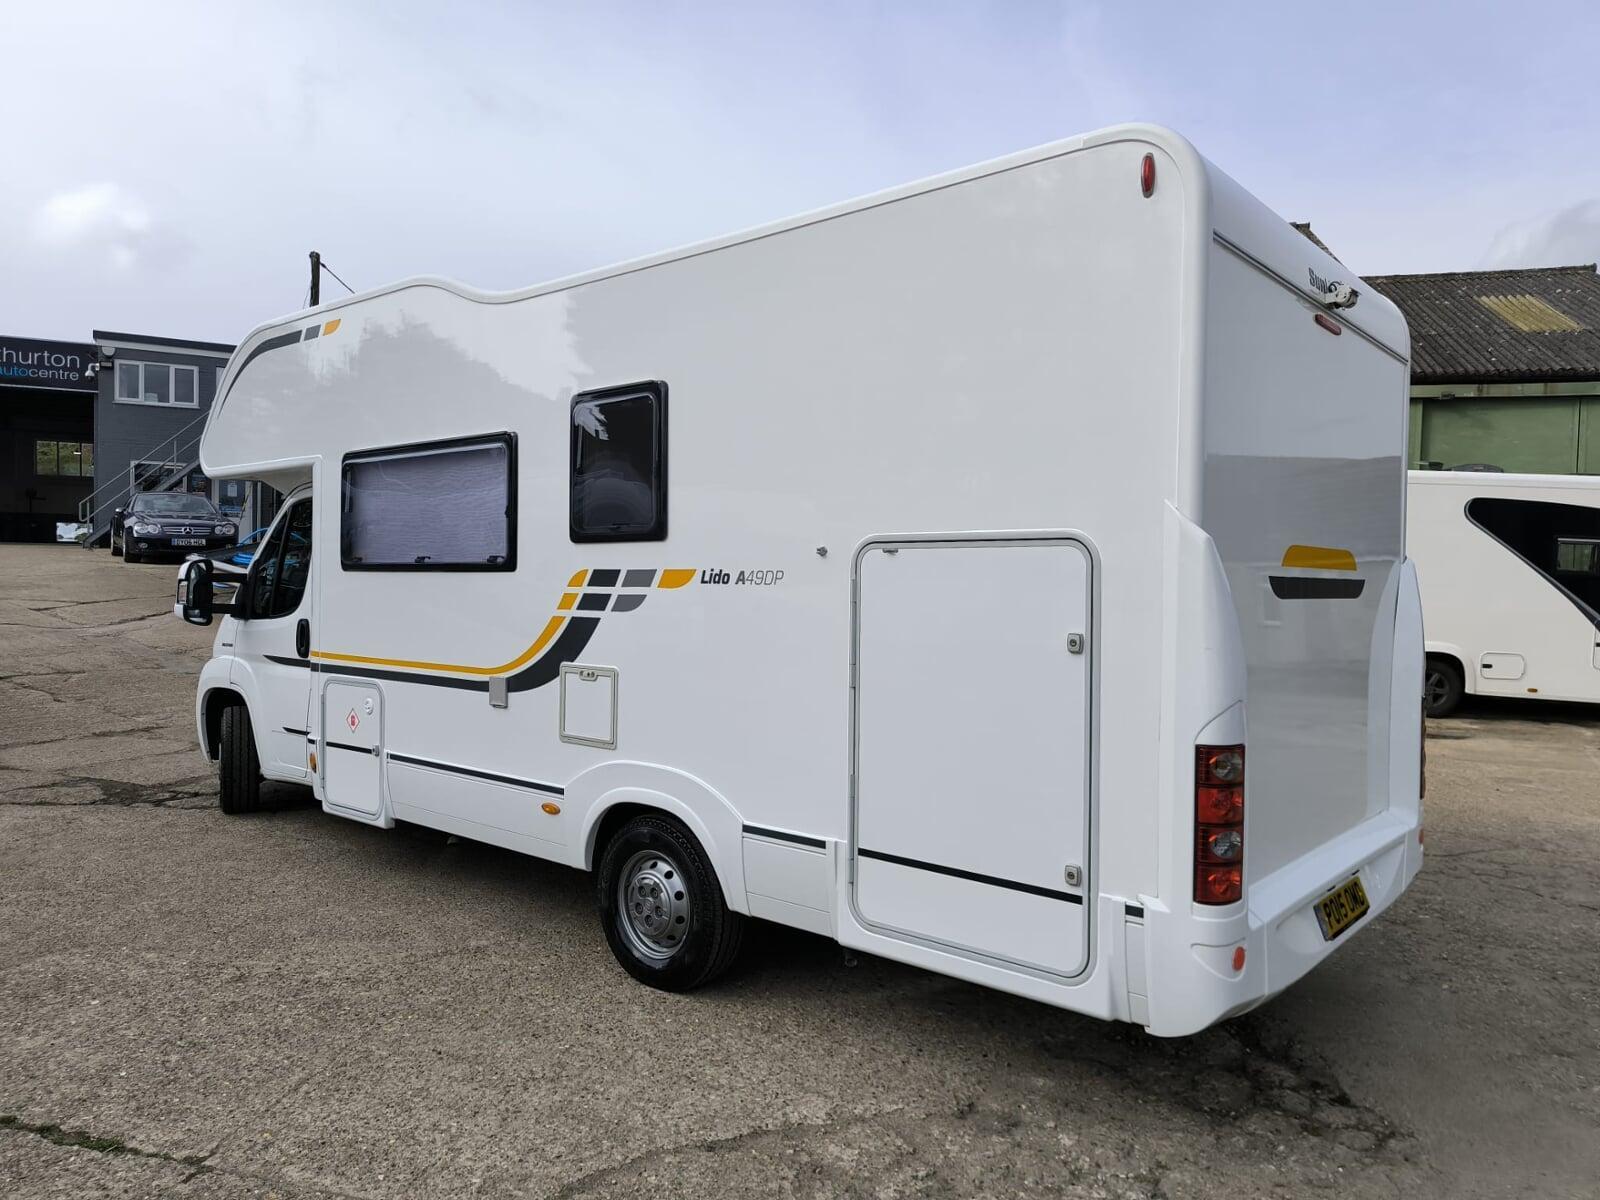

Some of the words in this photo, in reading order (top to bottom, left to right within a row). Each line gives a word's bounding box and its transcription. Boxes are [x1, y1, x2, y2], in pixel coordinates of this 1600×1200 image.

[0, 346, 80, 369] hurton
[700, 568, 731, 585] Lido
[735, 569, 785, 586] A49DP
